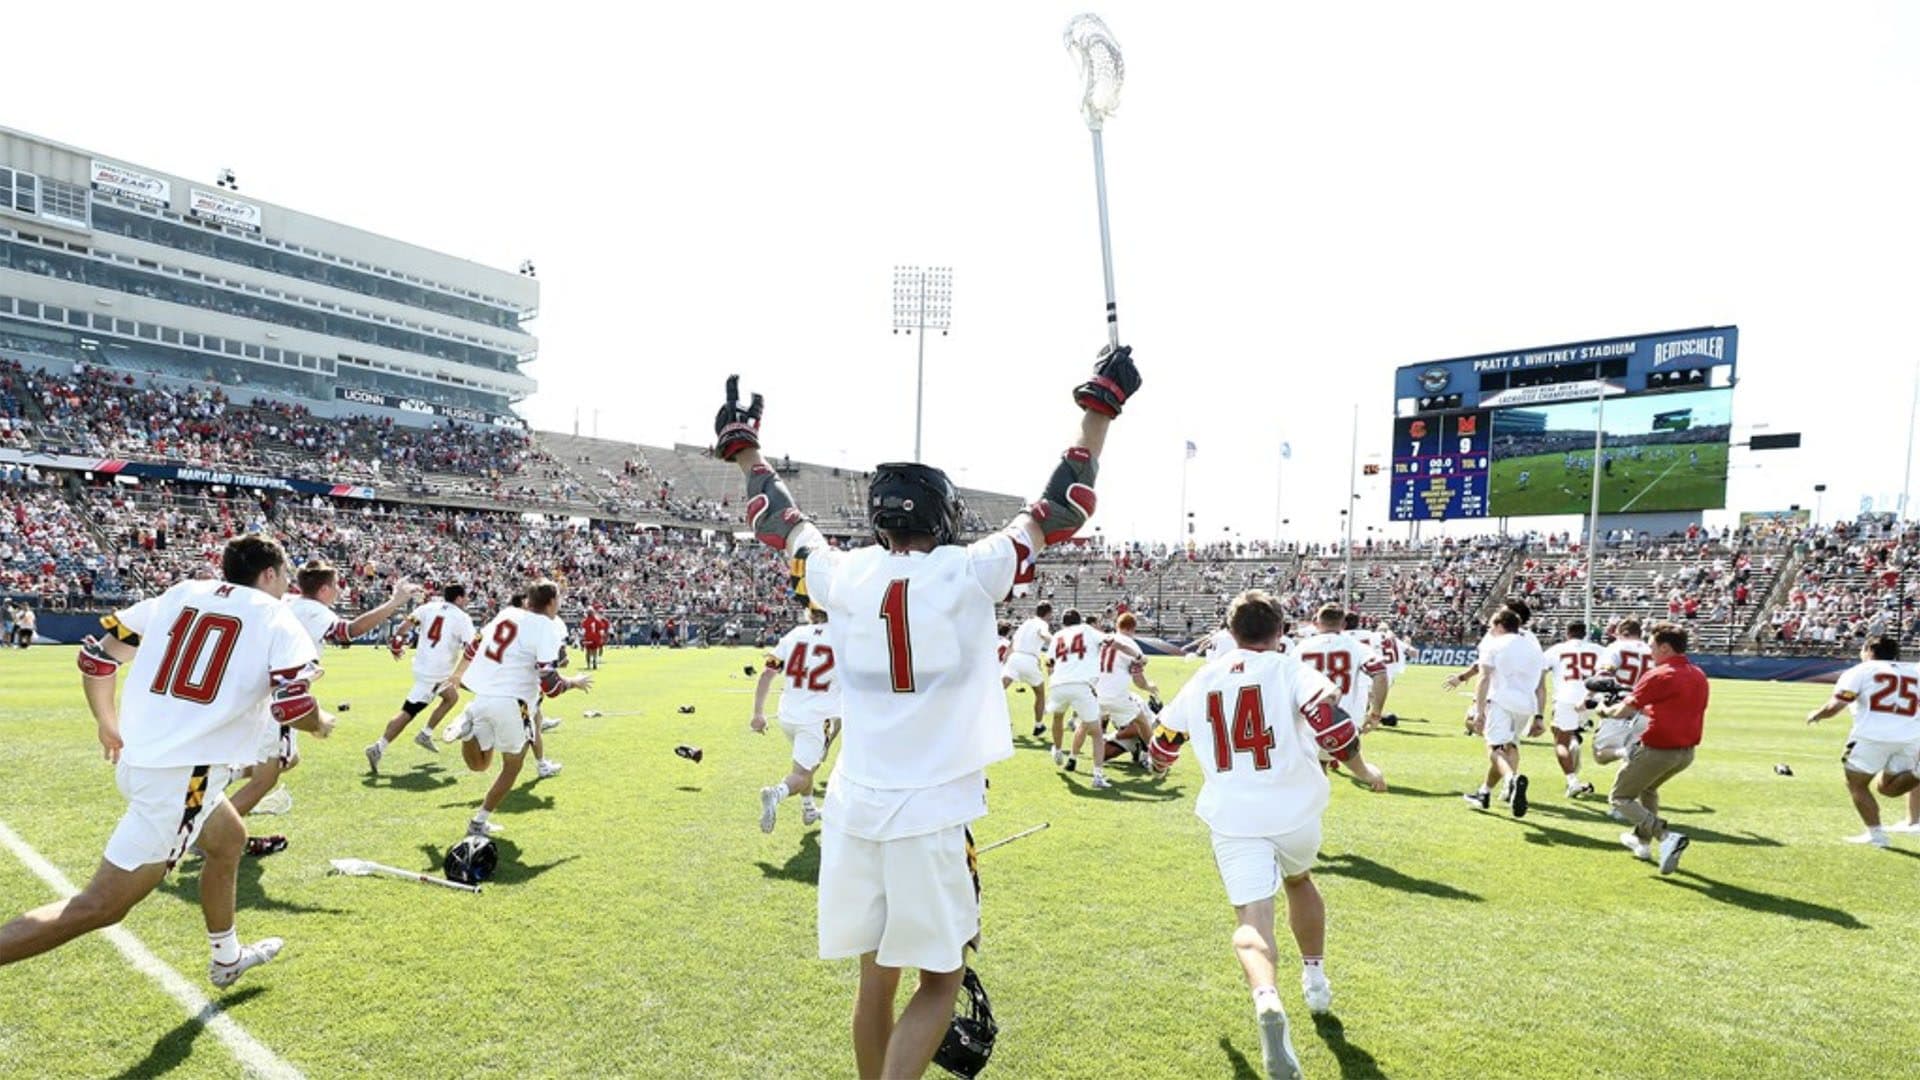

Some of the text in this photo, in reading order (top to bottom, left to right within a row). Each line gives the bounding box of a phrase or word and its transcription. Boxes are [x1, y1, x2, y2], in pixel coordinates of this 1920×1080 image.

[1473, 342, 1636, 371] PRATT & WHITNEY STADIUM
[1654, 336, 1724, 367] RENTSCHLER
[344, 390, 385, 405] UCONN
[442, 406, 485, 422] HUSKIES
[1412, 441, 1420, 457] 7
[1460, 438, 1471, 454] 9
[177, 469, 287, 491] MARYLAND TERRAPINS
[427, 615, 444, 648] 4
[485, 619, 518, 664] 9
[879, 578, 915, 693] 1
[150, 606, 243, 704] 10
[1055, 633, 1087, 662] 44
[786, 641, 836, 692] 42
[1302, 651, 1351, 695] 78
[1560, 651, 1597, 682] 39
[1870, 672, 1918, 717] 25
[1206, 684, 1276, 773] 14
